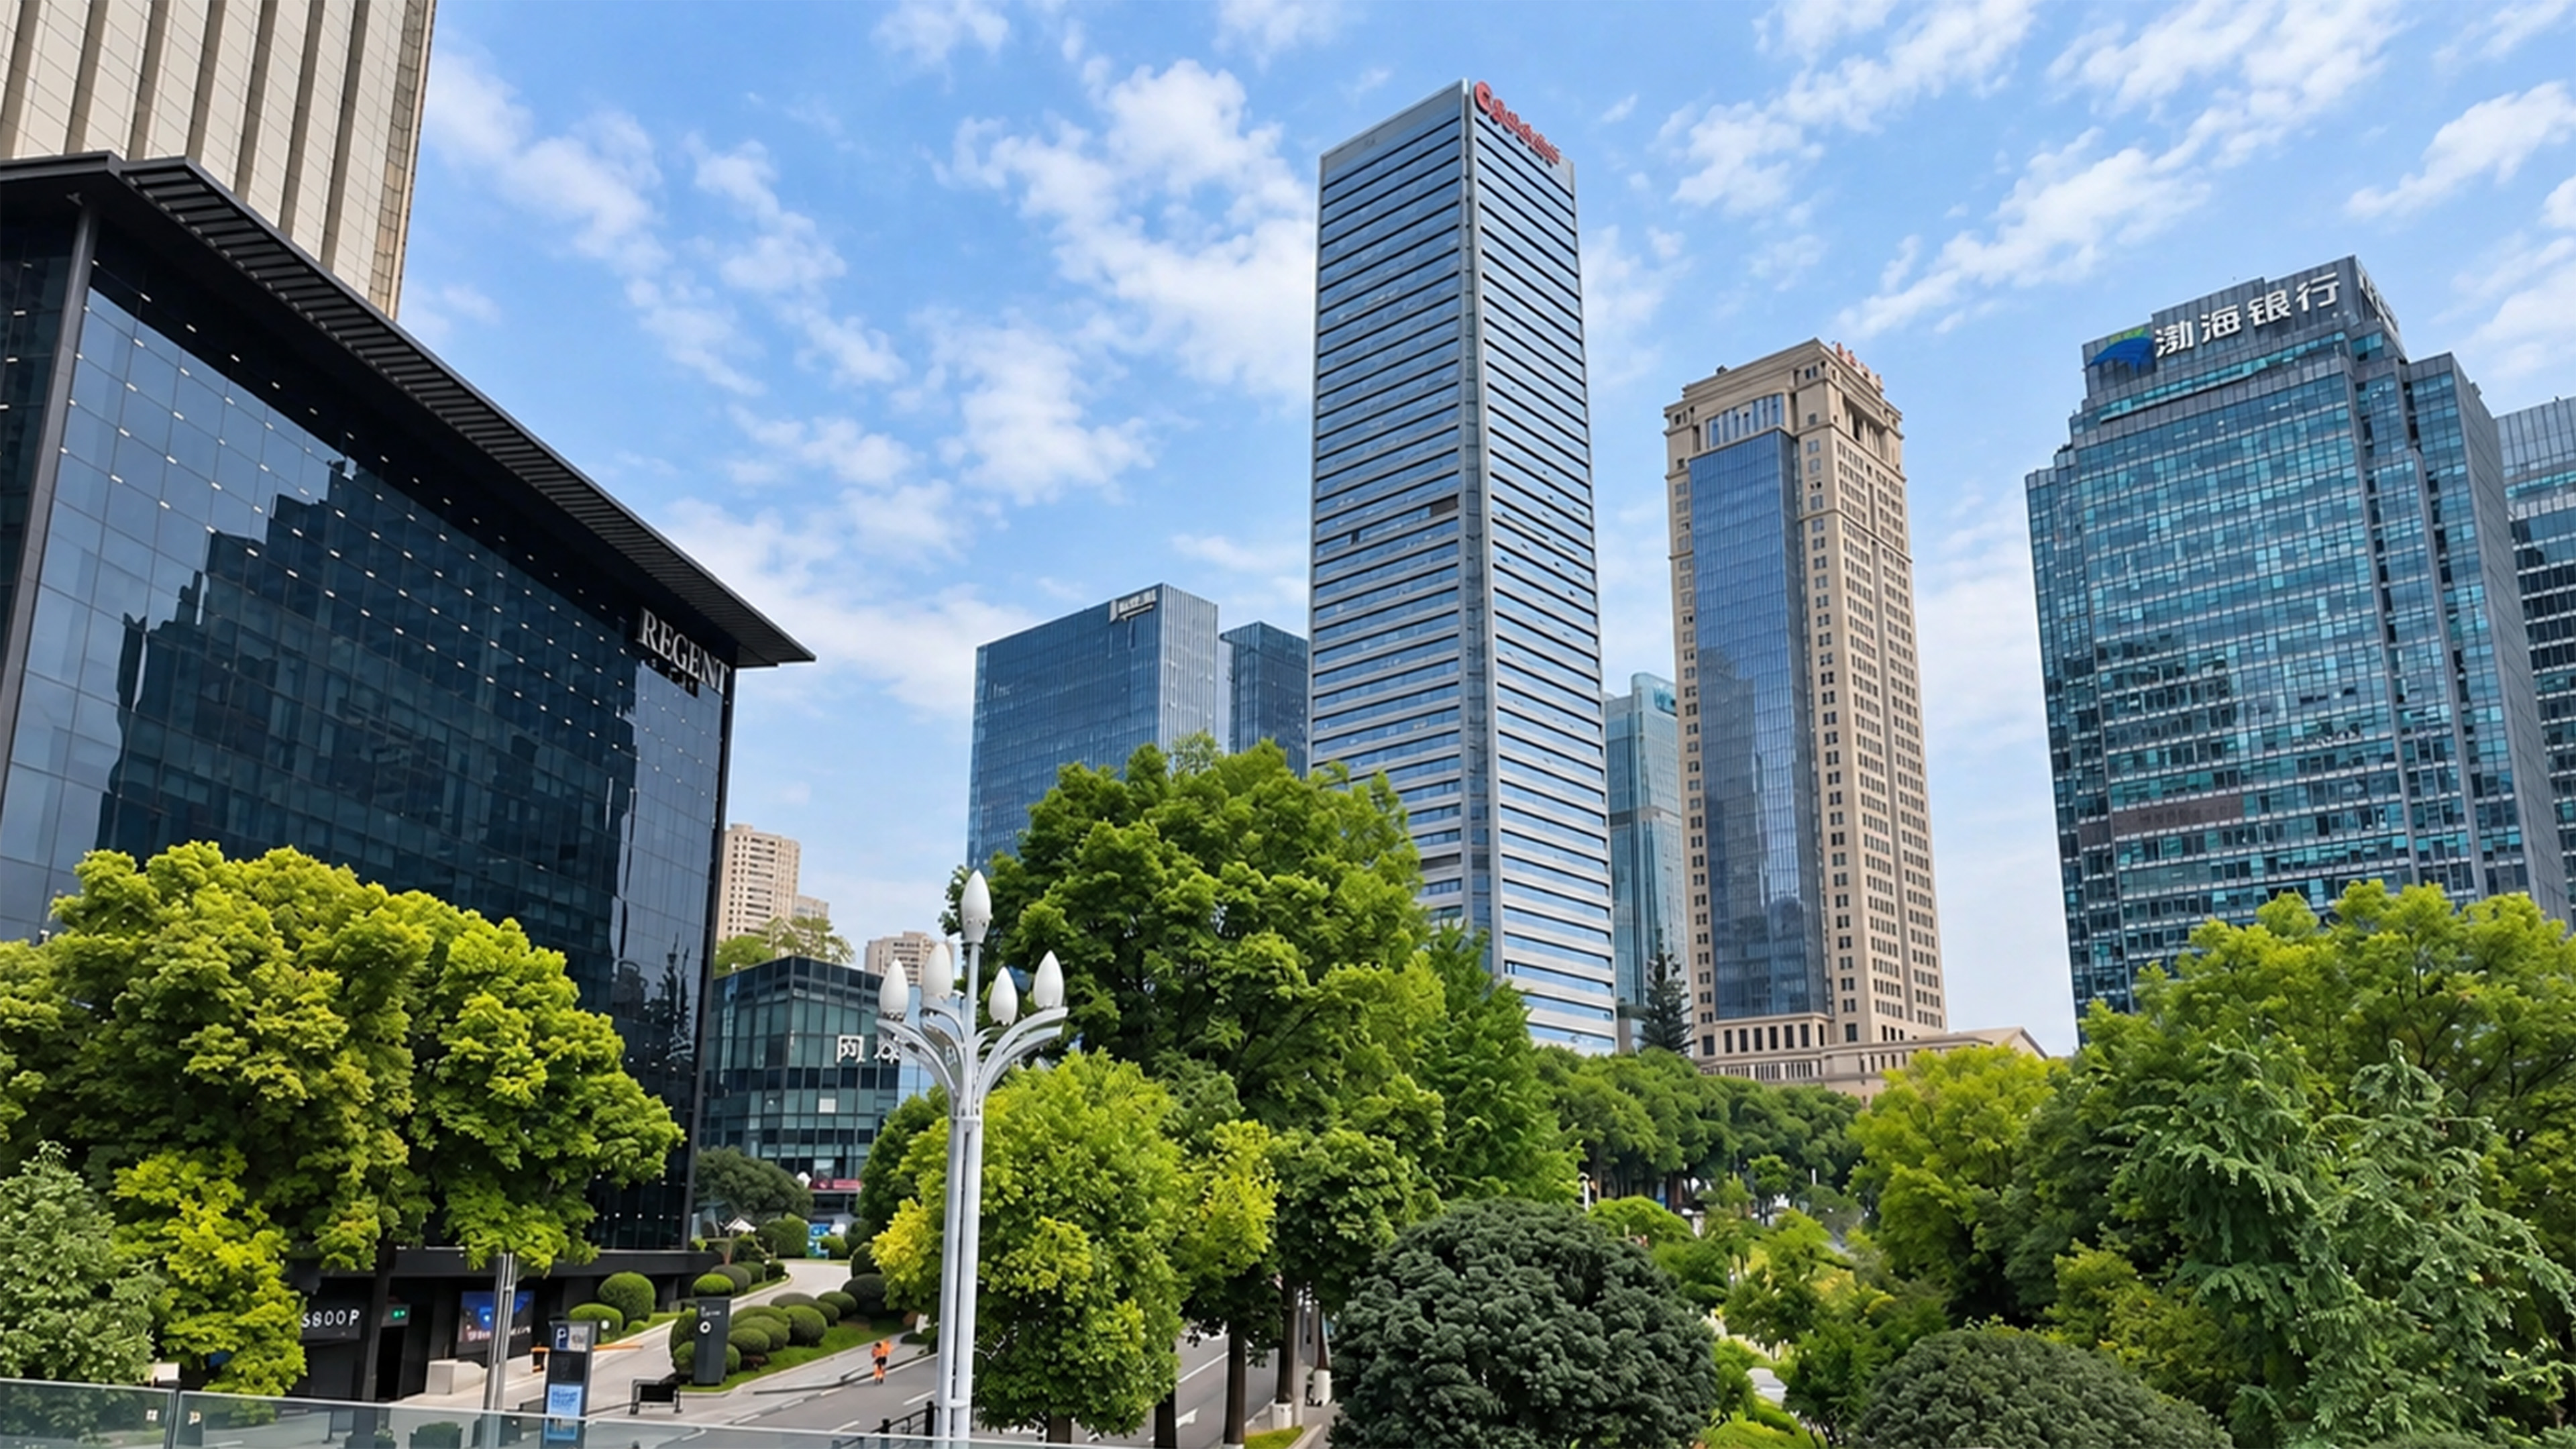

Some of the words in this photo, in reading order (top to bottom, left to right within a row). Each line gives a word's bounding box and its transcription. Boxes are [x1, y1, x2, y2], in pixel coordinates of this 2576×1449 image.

[2155, 272, 2340, 358] 渤海银行
[636, 606, 731, 694] REGENT
